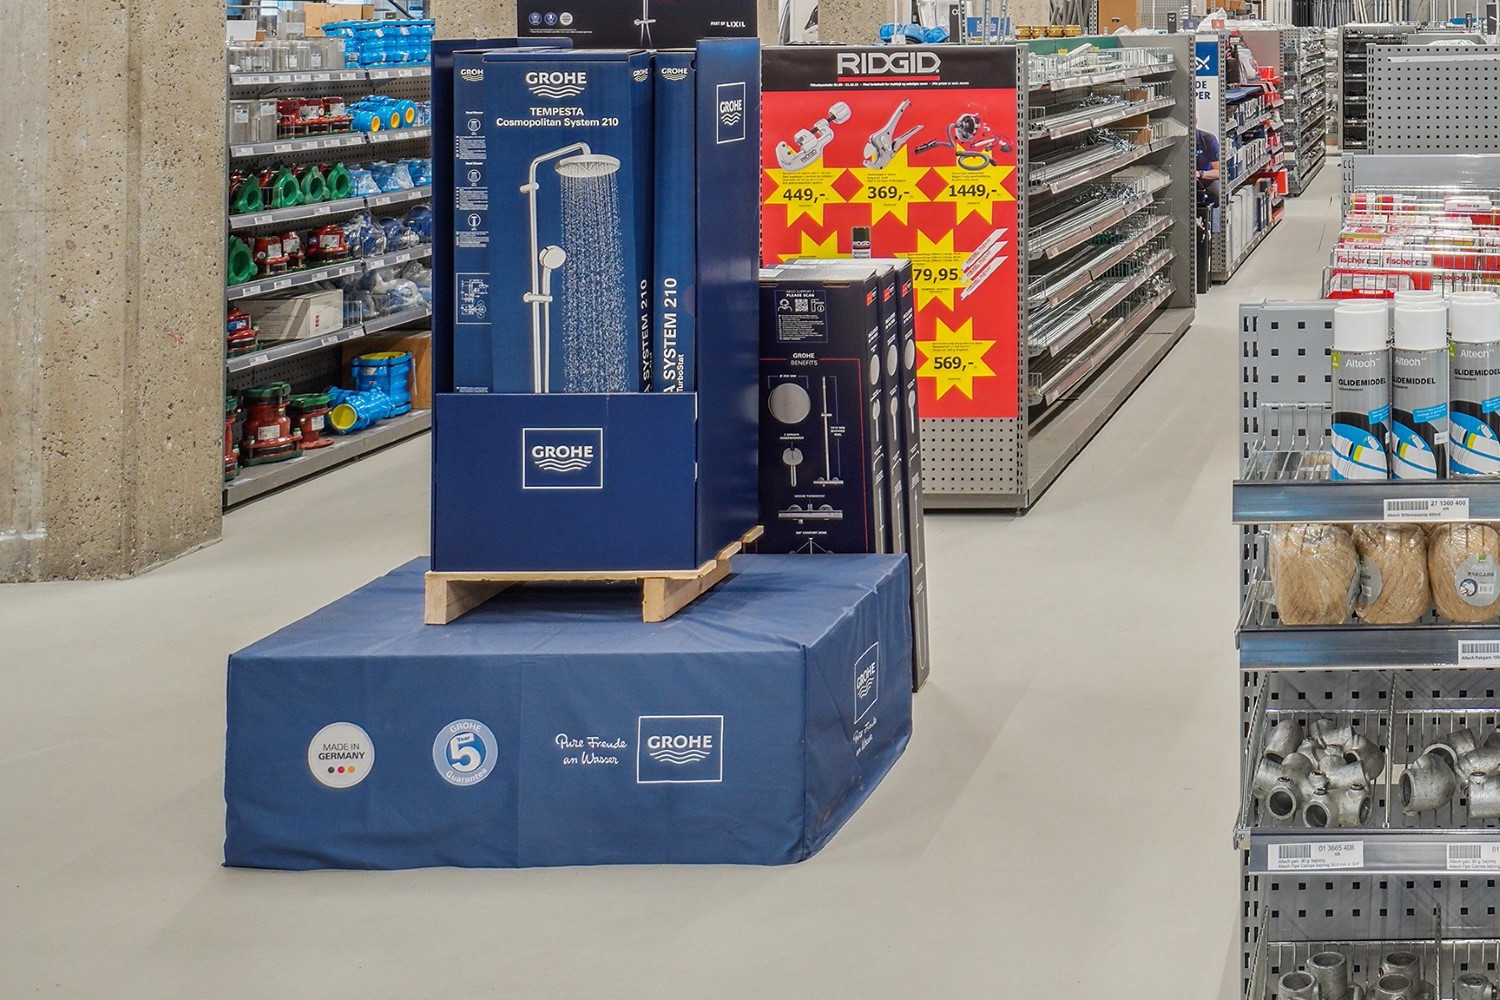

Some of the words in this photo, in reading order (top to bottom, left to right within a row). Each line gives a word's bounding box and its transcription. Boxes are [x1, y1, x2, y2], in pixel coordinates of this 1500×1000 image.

[837, 51, 942, 75] RIDGID
[632, 67, 649, 78] GROHE
[661, 67, 688, 76] GROHE
[525, 72, 587, 85] GROHE
[530, 107, 584, 116] TEMPESTA
[719, 99, 743, 114] GROHE
[496, 117, 562, 128] Cosmopolitan
[563, 117, 599, 128] System
[601, 117, 619, 127] 210
[783, 188, 826, 203] 449,-
[867, 186, 910, 200] 369,-
[948, 184, 997, 199] 1449,-
[1337, 255, 1366, 264] fischer
[1386, 255, 1415, 265] fischer
[640, 279, 648, 309] 210
[664, 277, 677, 308] 210
[641, 313, 650, 381] SYSTEM
[663, 313, 677, 380] SYSTEM
[1460, 349, 1490, 359] Altech
[933, 356, 974, 372] 569,-
[1345, 358, 1376, 368] Altech
[1394, 356, 1421, 367] Altech
[1453, 368, 1500, 376] GLIDEMIDDEL
[1338, 376, 1387, 387] GLIDEMIDDEL
[531, 446, 594, 458] GROHE
[857, 661, 876, 690] GROHE
[450, 721, 482, 733] GROHE
[456, 735, 471, 743] Year
[555, 733, 584, 749] Pure
[587, 736, 628, 749] Freude
[647, 735, 713, 749] GROHE
[323, 743, 349, 752] MADE
[350, 743, 360, 751] IN
[450, 733, 482, 772] 5
[318, 752, 365, 761] GERMANY
[563, 757, 578, 765] an
[582, 751, 620, 765] Wasser
[445, 768, 488, 783] Guarantee
